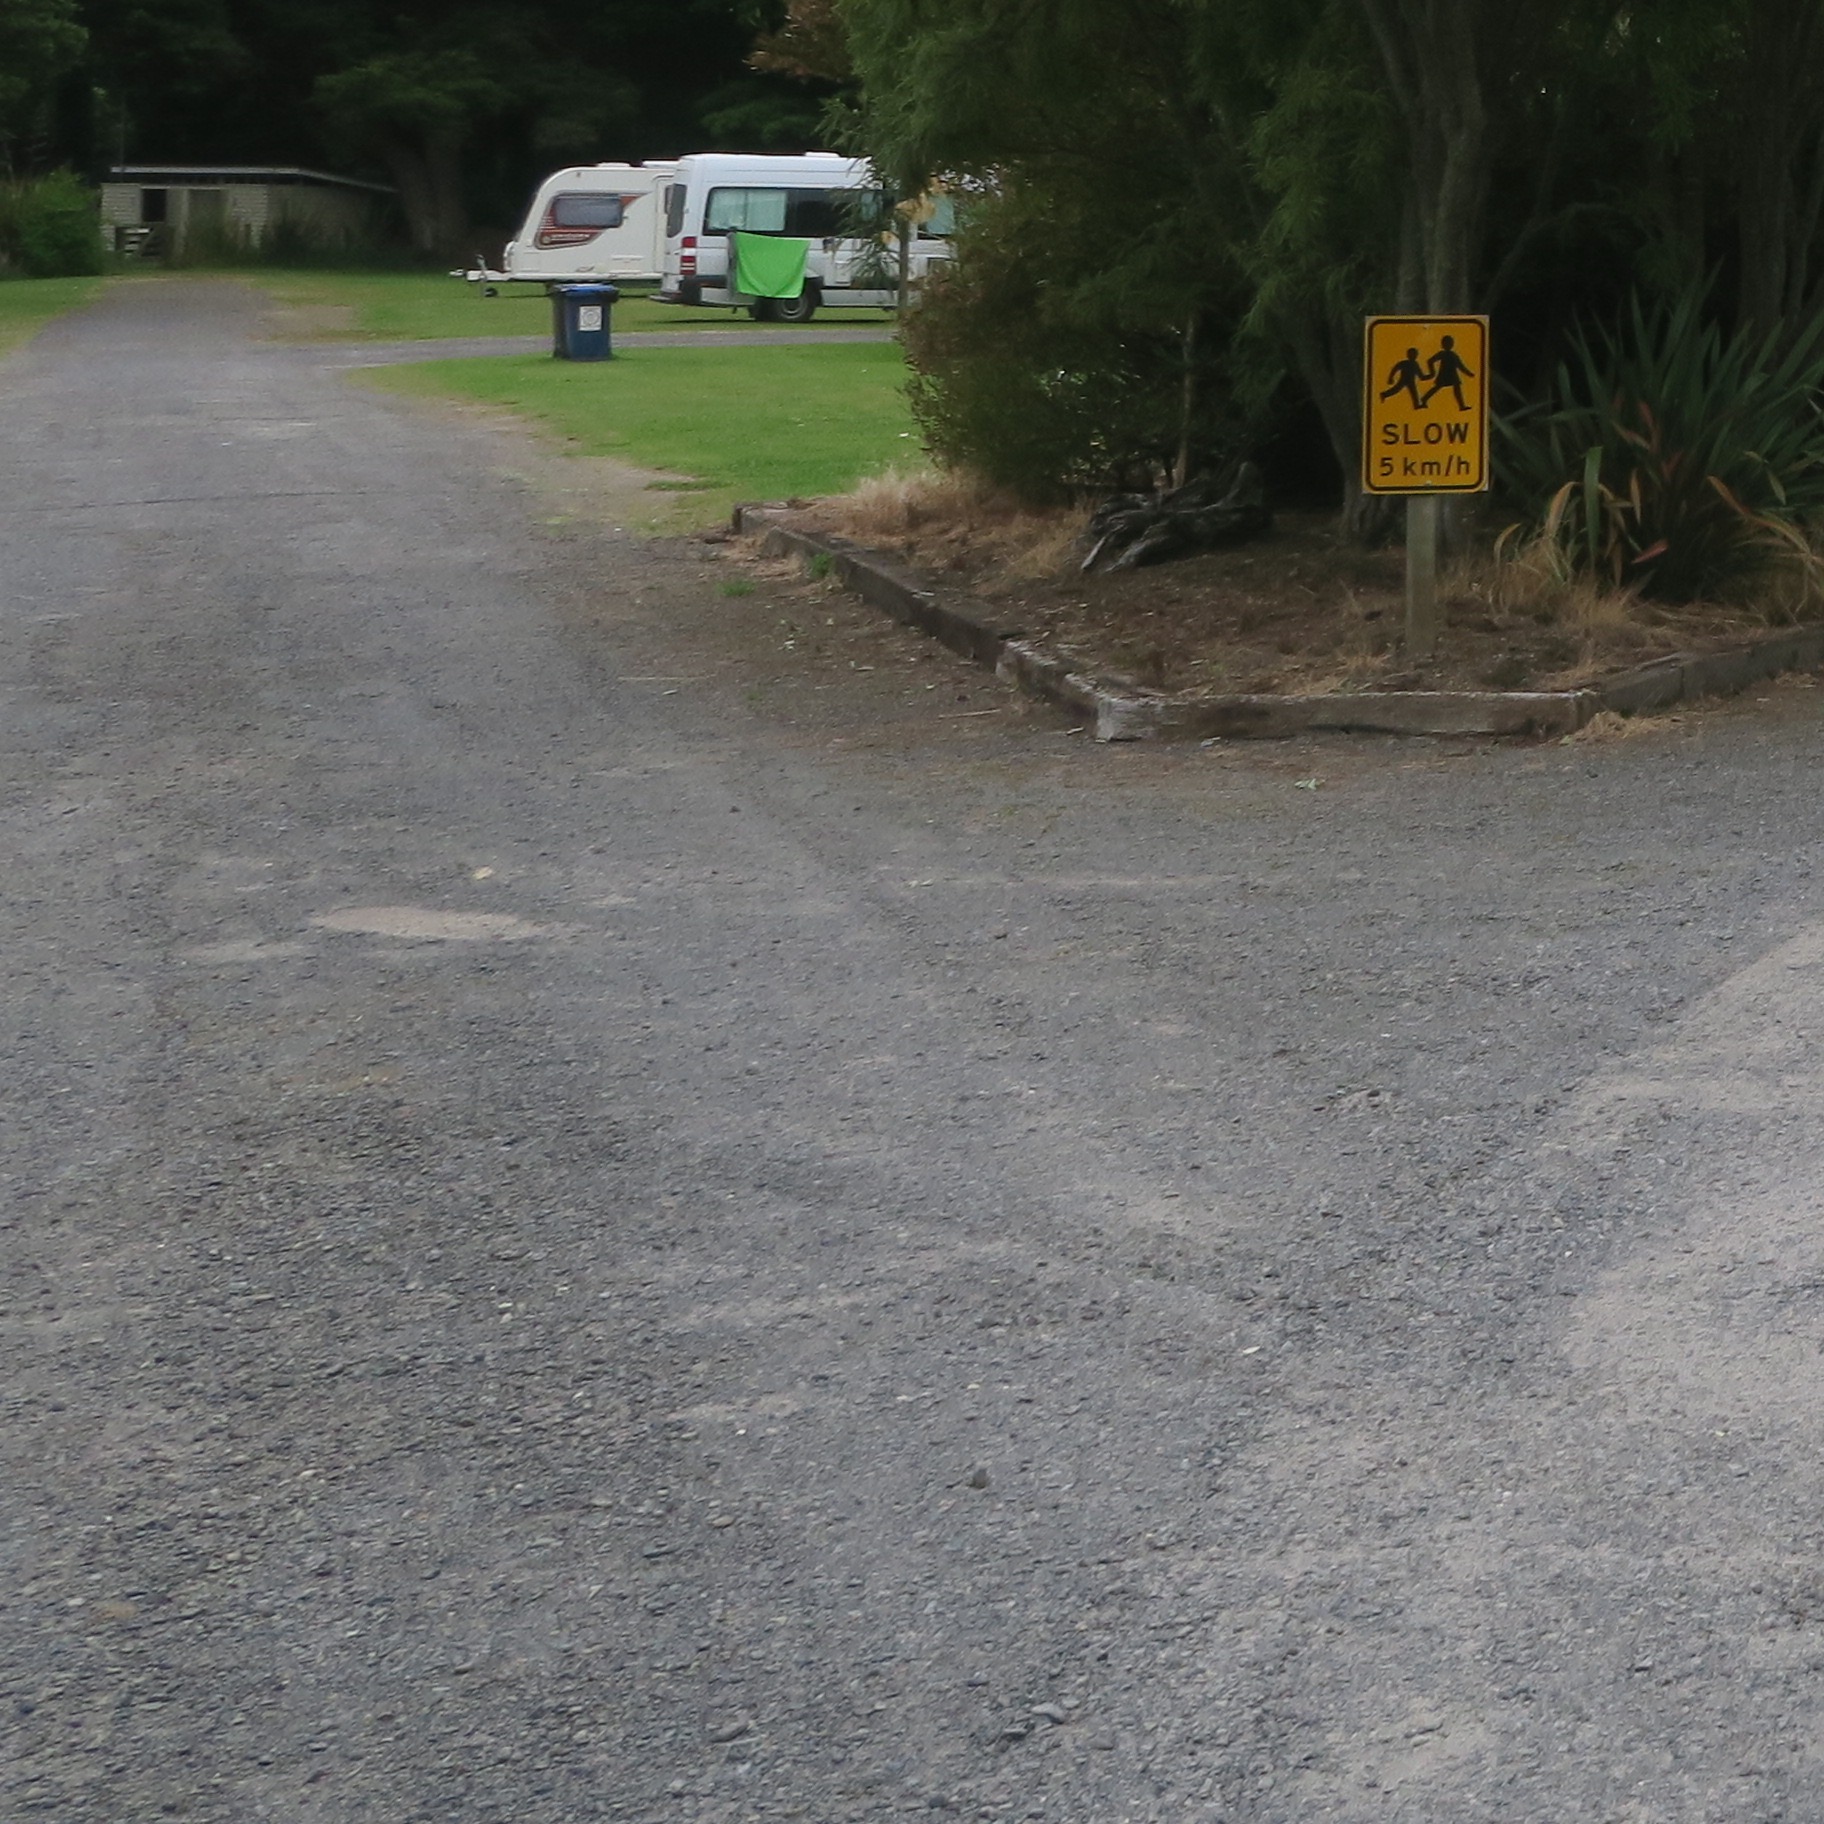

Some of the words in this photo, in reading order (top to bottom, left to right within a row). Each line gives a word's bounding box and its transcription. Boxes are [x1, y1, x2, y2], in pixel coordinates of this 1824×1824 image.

[1382, 423, 1469, 445] SLOW
[1380, 457, 1394, 476] 5
[1403, 455, 1470, 476] km/h
